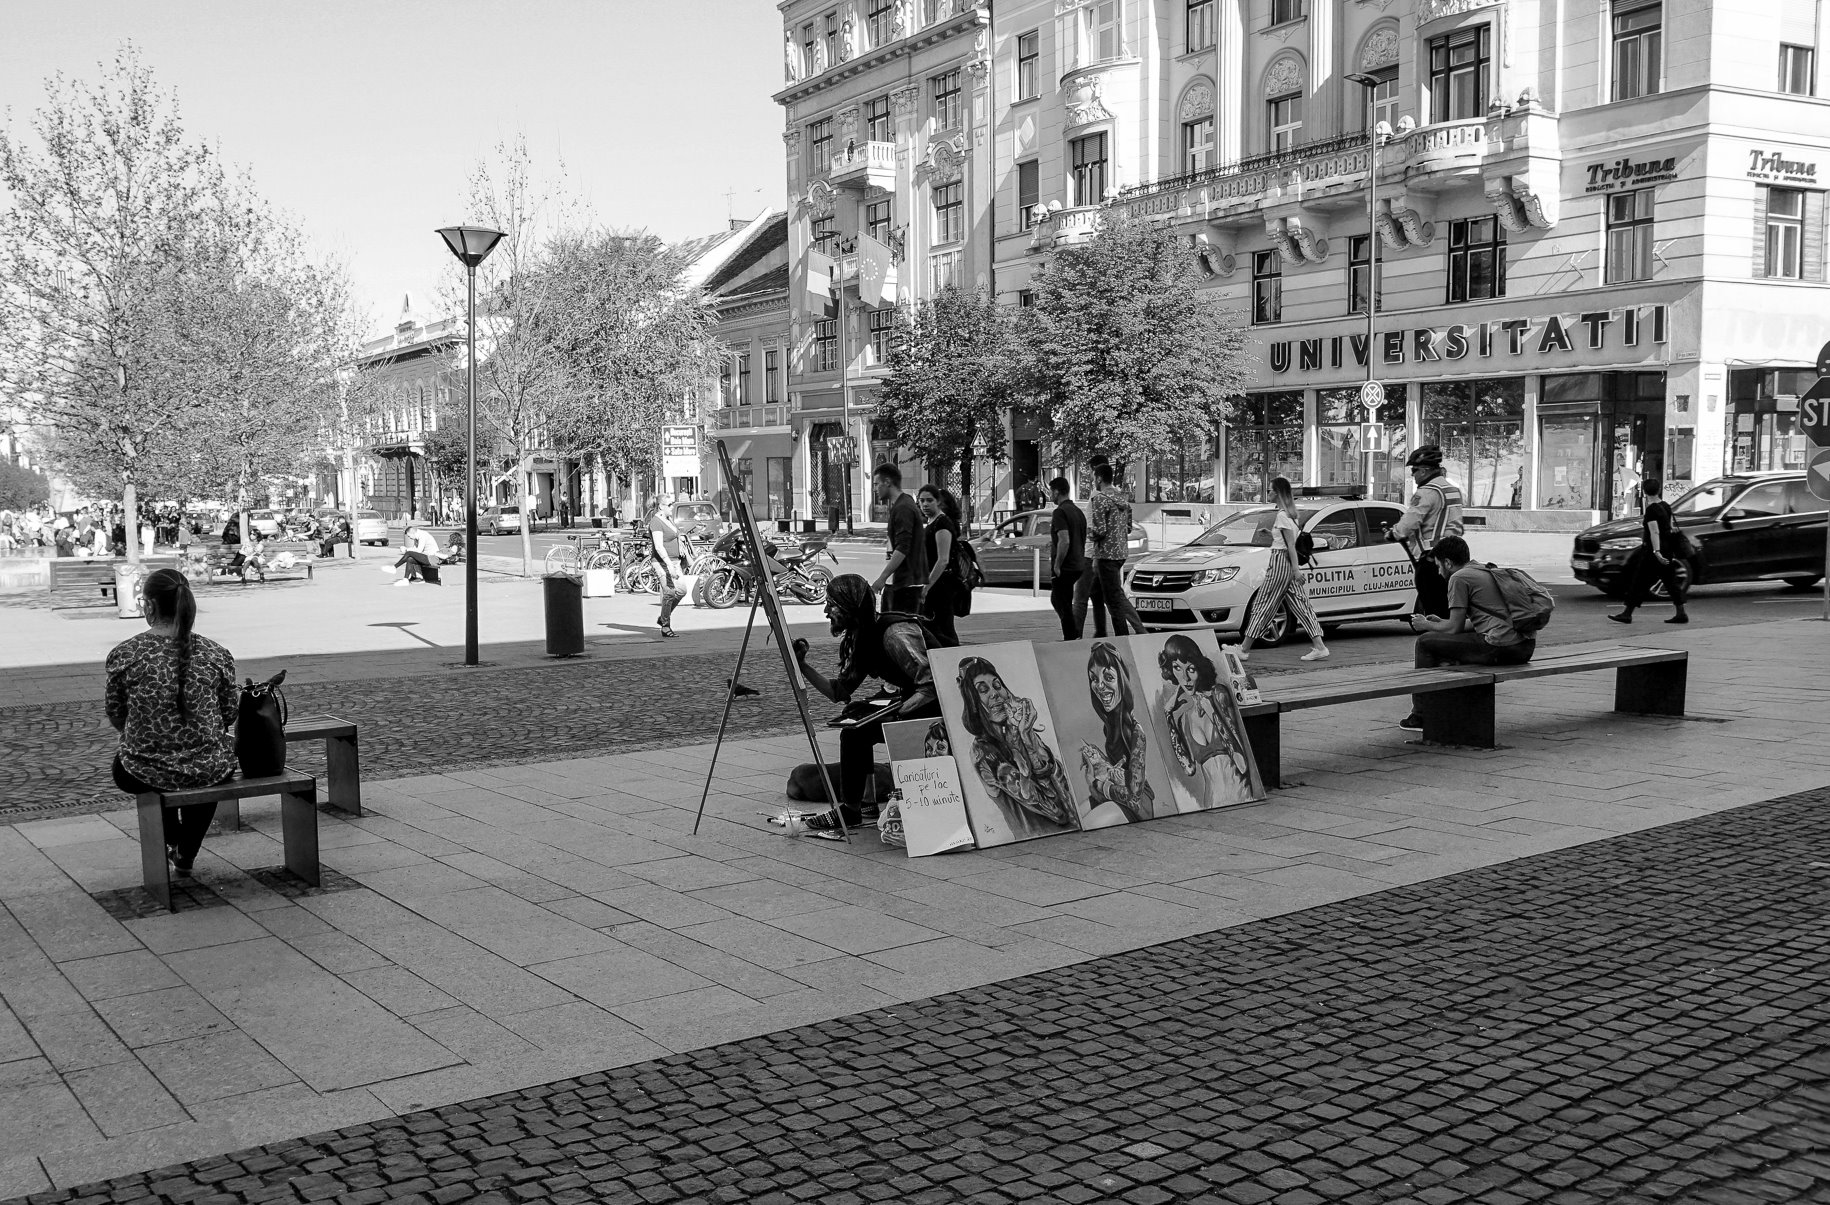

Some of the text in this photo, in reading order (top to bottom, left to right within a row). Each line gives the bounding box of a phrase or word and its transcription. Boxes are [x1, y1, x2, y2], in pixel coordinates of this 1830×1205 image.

[1587, 158, 1675, 184] Tribuna
[1750, 150, 1816, 176] Tribuna
[1270, 305, 1668, 373] UNIVERSITATII
[1307, 564, 1413, 583] POLITIA LOCALA
[1309, 579, 1414, 596] MUNICIPIUL CLUJ-NAPOCA
[897, 763, 940, 784] Caricaturi
[919, 784, 929, 796] pe
[932, 791, 960, 806] minute
